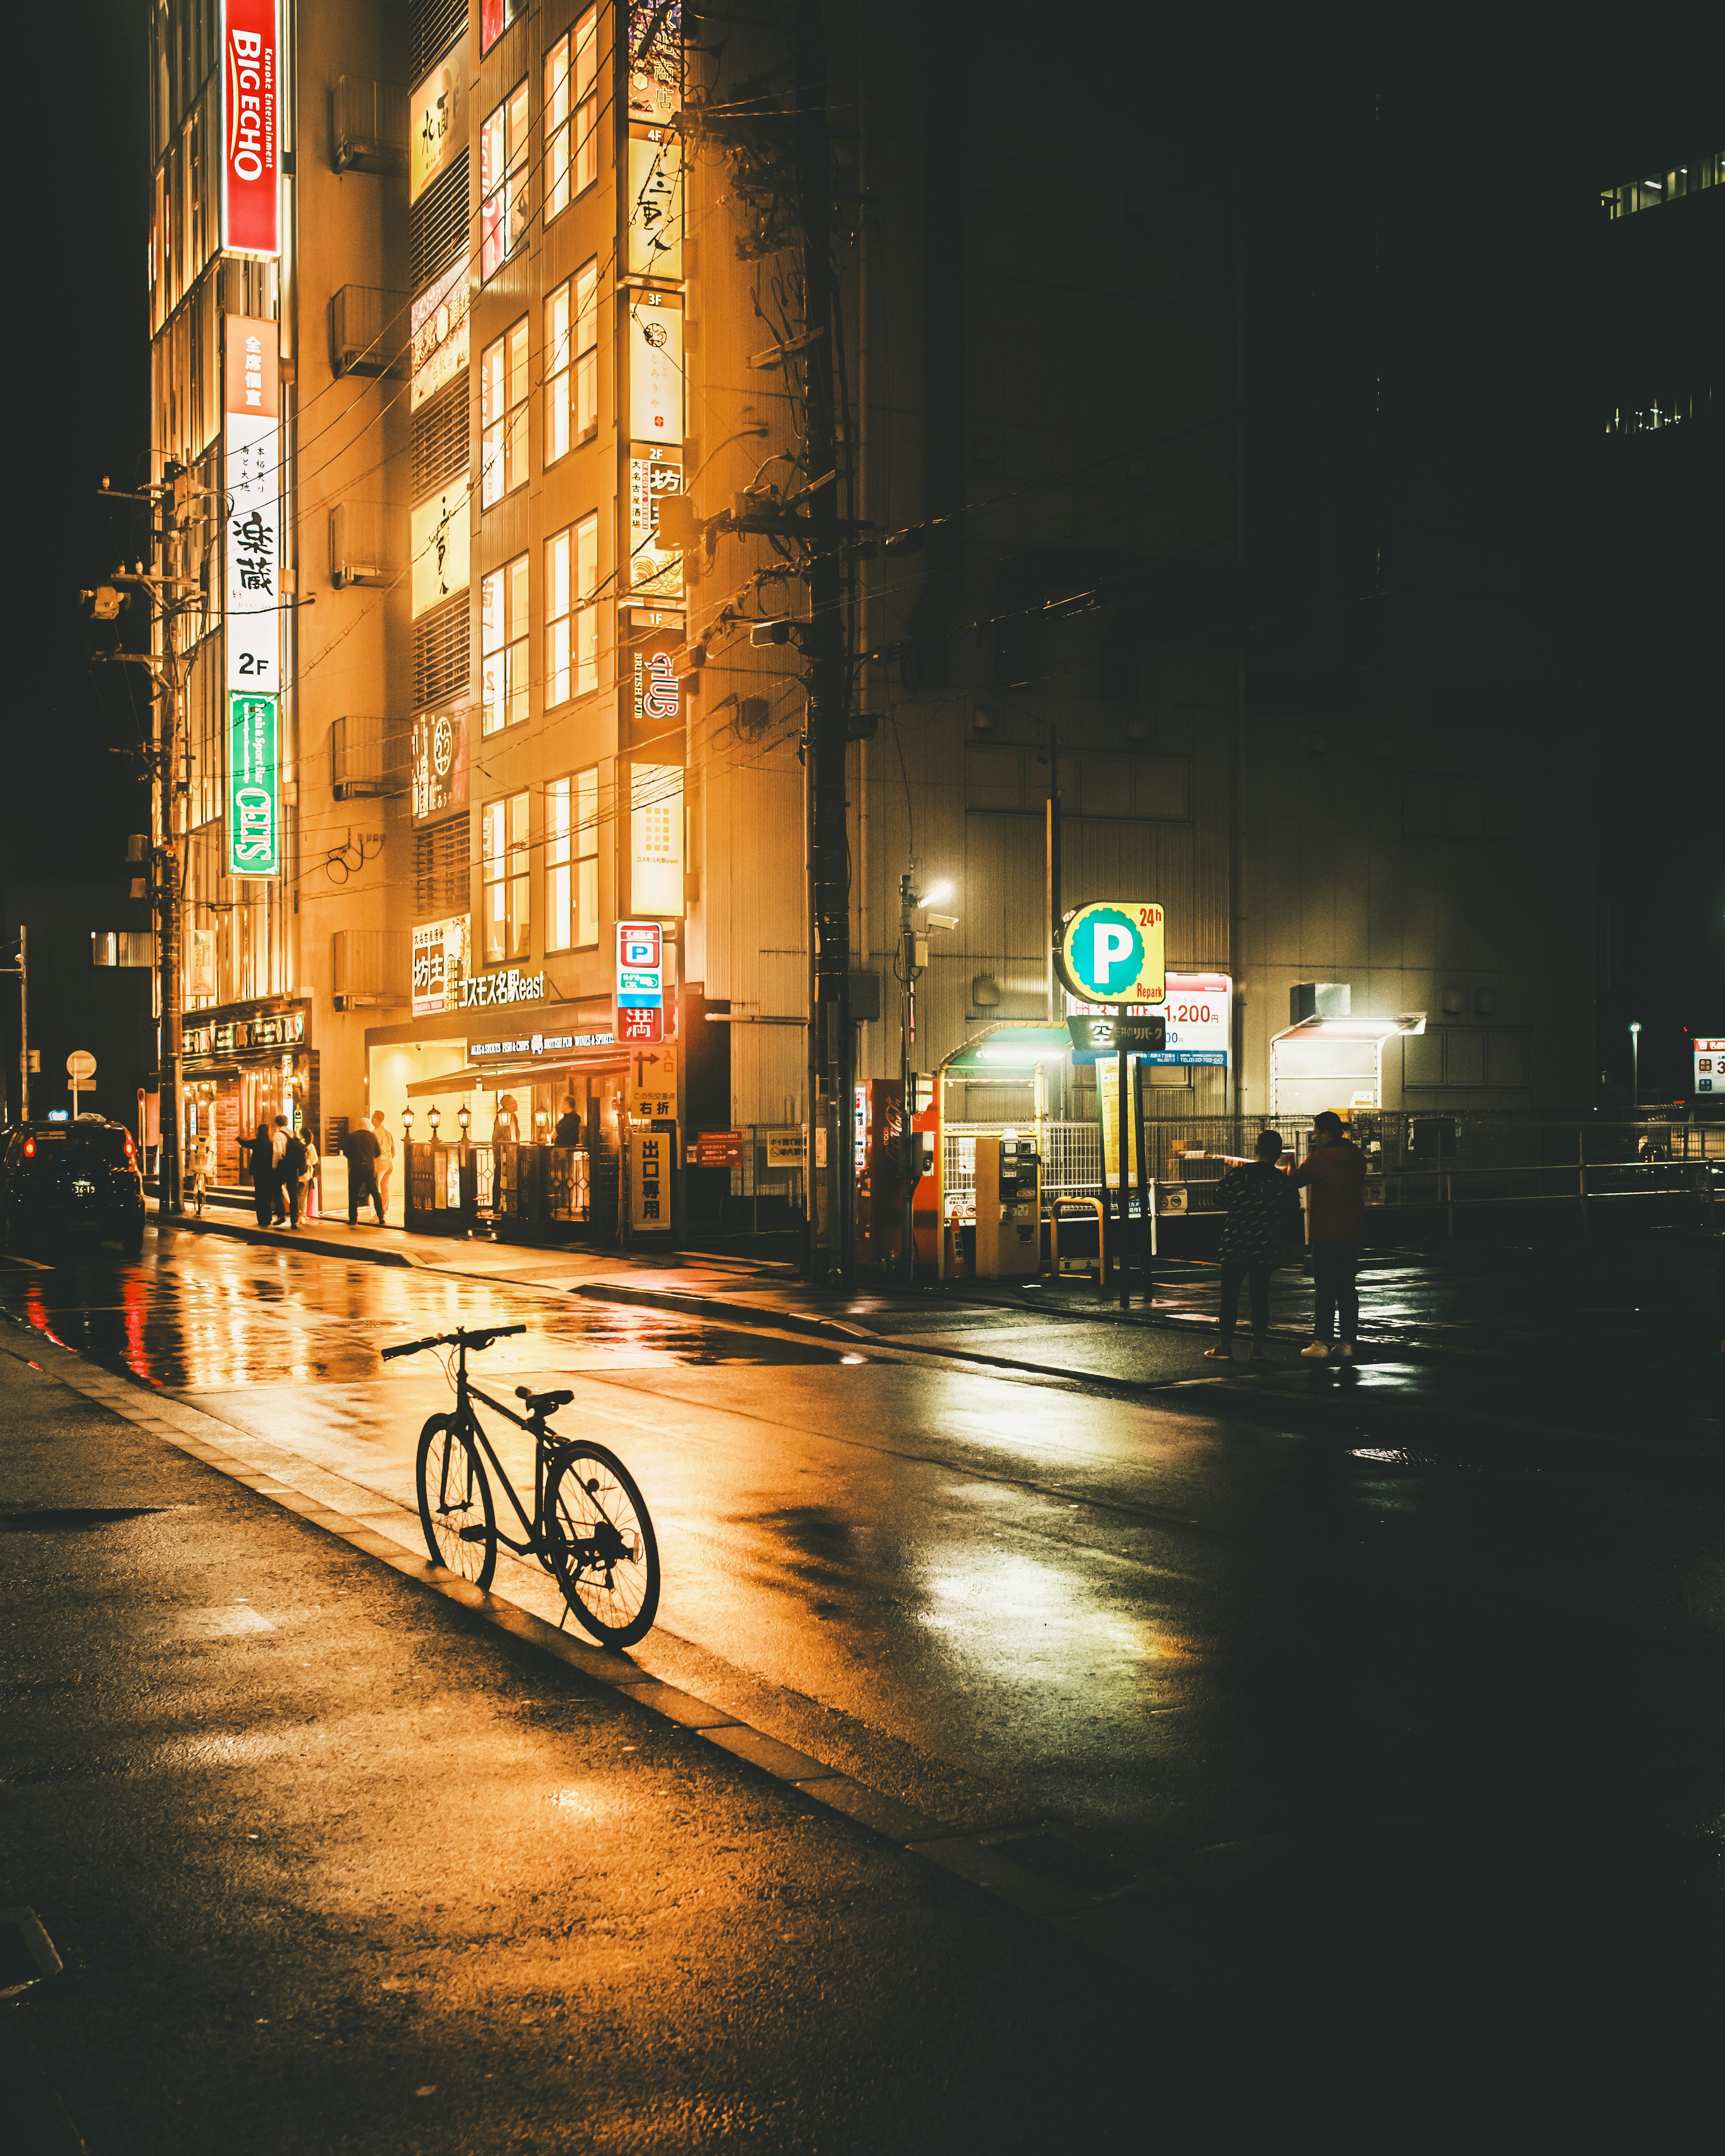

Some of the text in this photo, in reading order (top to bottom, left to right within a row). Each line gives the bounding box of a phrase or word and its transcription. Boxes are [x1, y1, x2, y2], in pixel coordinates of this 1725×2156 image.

[232, 29, 262, 181] BIG ECHO
[264, 48, 274, 168] Karaoke Entertainment
[648, 129, 661, 141] 4F
[649, 293, 661, 305] 3F
[245, 336, 262, 407] 全席個室
[240, 446, 250, 491] 海と大地
[650, 448, 663, 460] 2F
[632, 460, 641, 529] 大名古屋酒場
[650, 469, 680, 525] 坊
[232, 511, 274, 596] 楽蔵
[650, 613, 663, 625] 1F
[239, 653, 269, 675] 2F
[634, 652, 643, 719] BRITISH PUB
[644, 652, 679, 719] HUB
[252, 737, 265, 766] Sport
[255, 766, 265, 784] Bar
[235, 787, 271, 861] CELTS
[1140, 908, 1161, 927] 24h
[414, 928, 444, 945] 大名古屋酒場
[632, 946, 648, 959] P
[1094, 923, 1133, 984] P
[414, 953, 444, 987] 坊主
[458, 969, 544, 1007] コスモス名駅east
[1137, 983, 1162, 999] Repark
[626, 1009, 654, 1038] 満
[1164, 1005, 1219, 1023] 1,200円
[1090, 1019, 1115, 1046] 空
[663, 1050, 673, 1072] 入口
[640, 1102, 669, 1115] 右折
[642, 1140, 660, 1219] 出口専用
